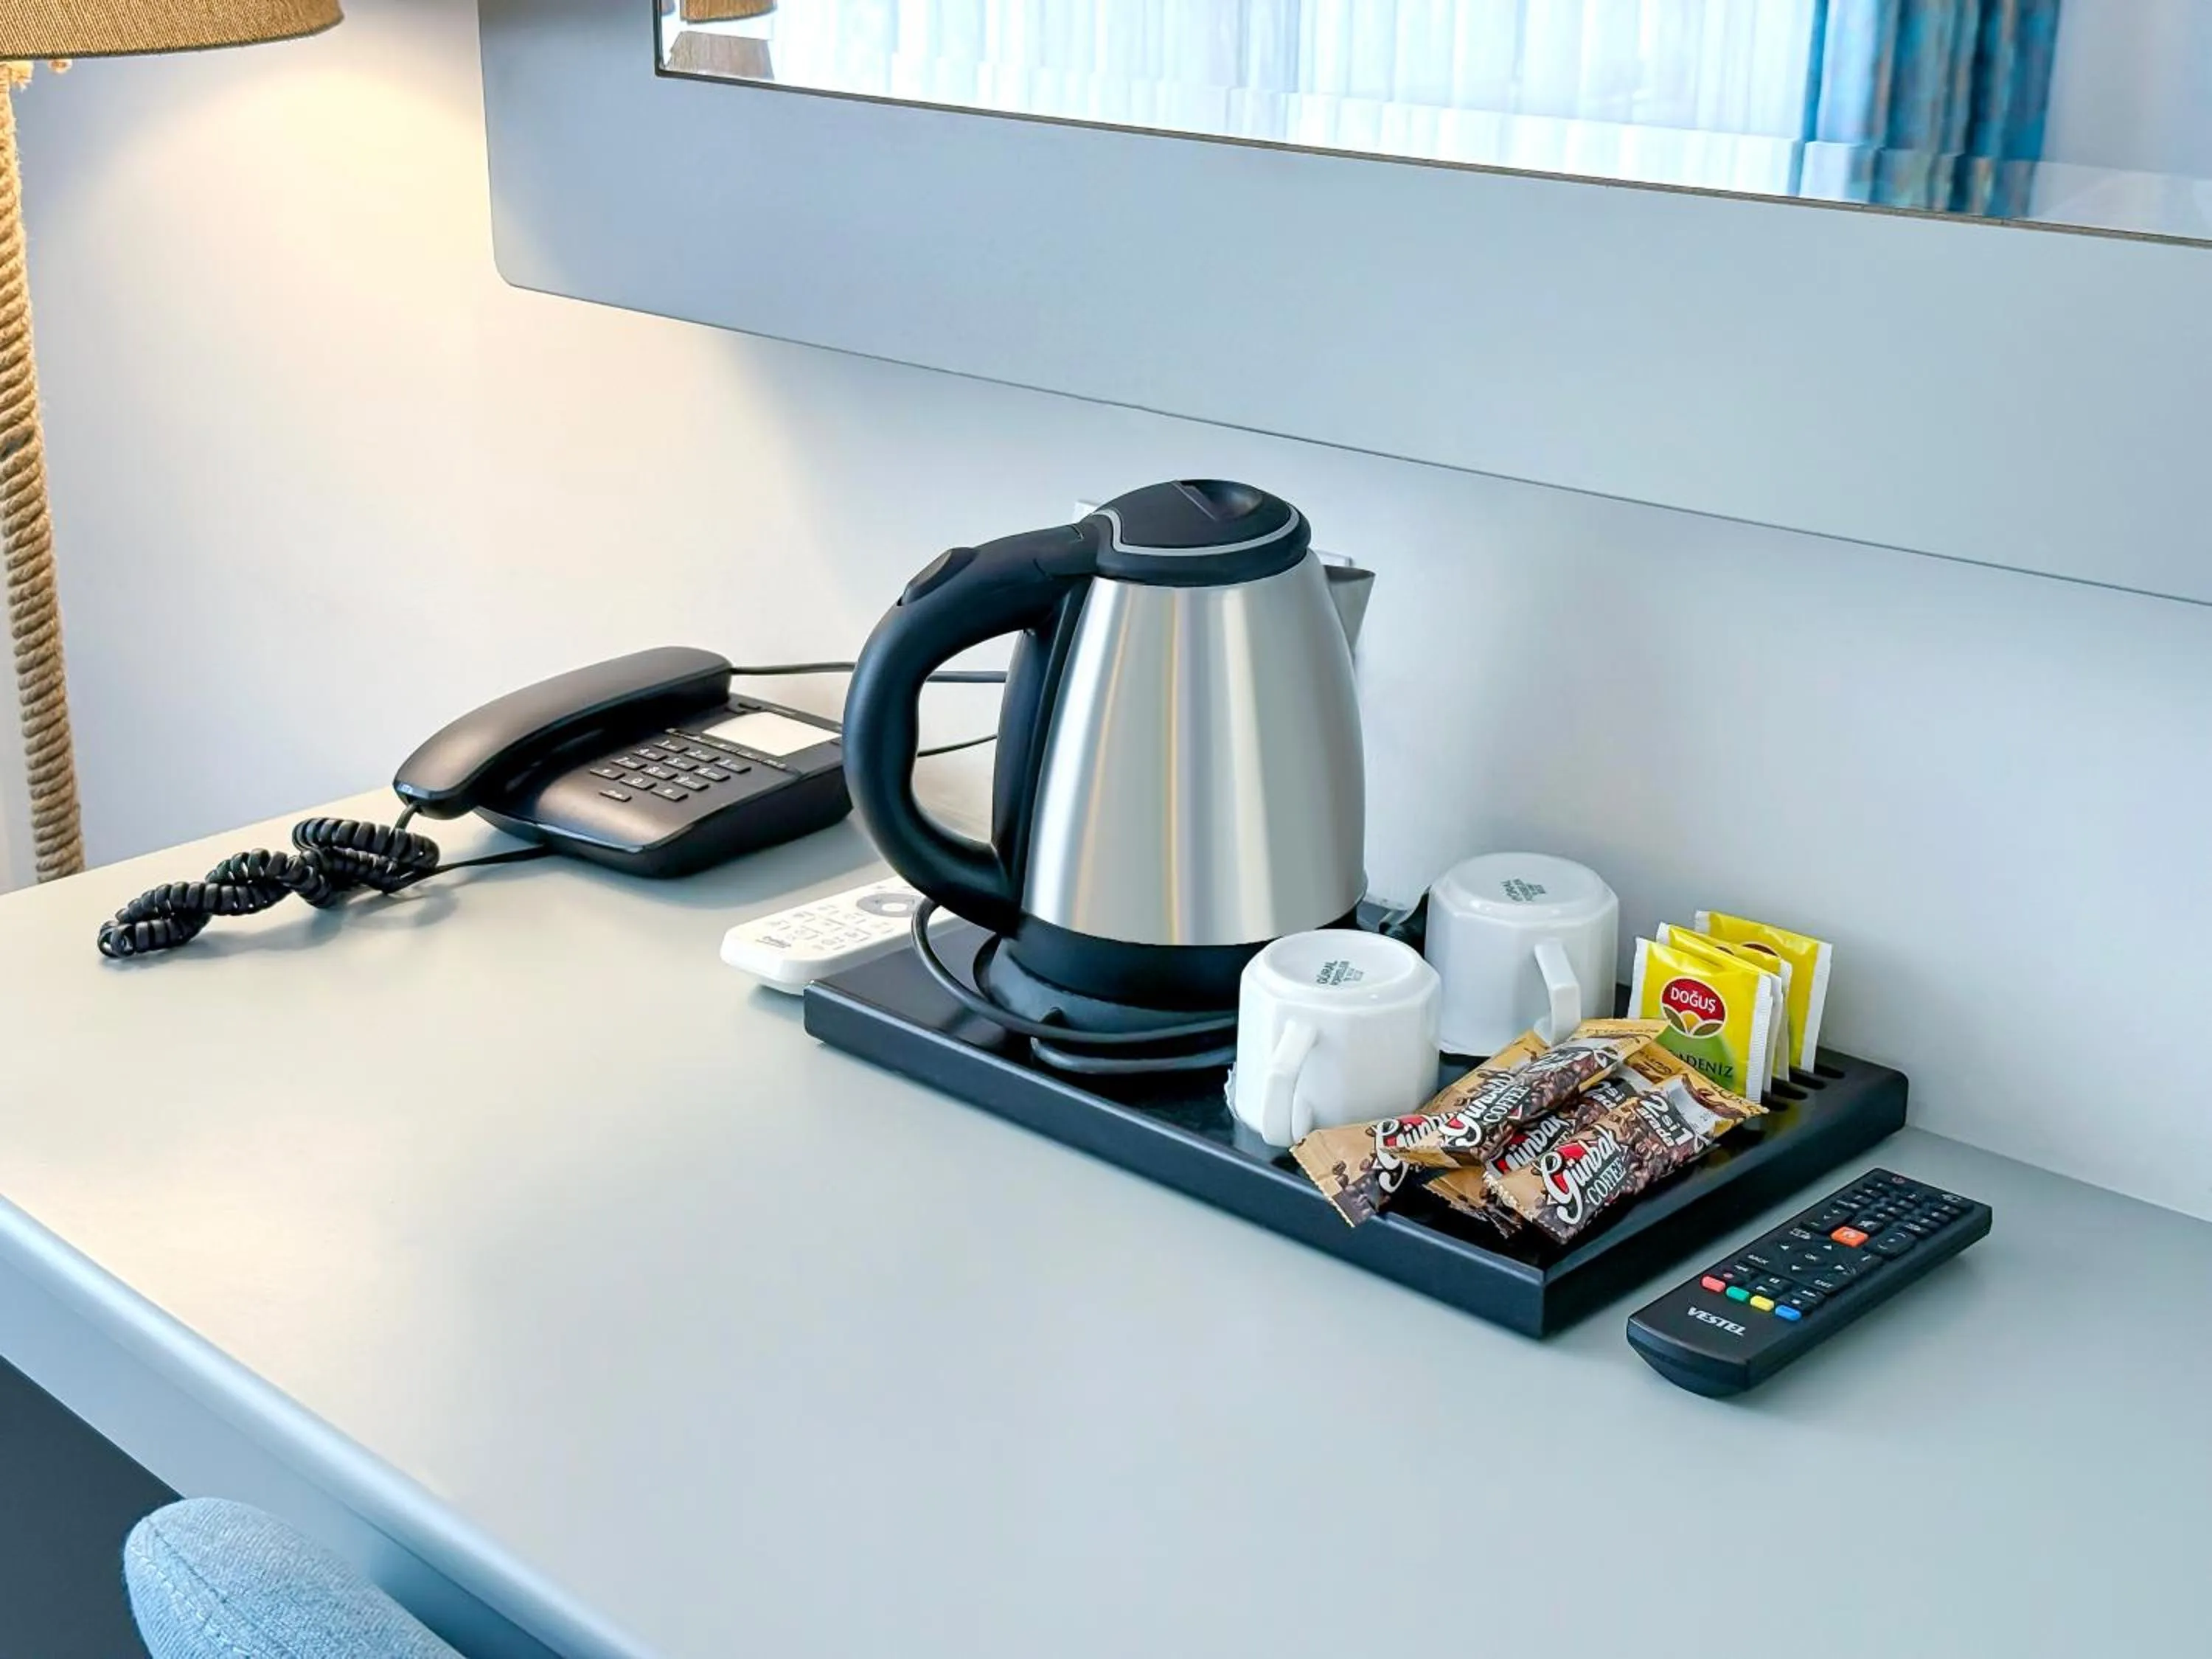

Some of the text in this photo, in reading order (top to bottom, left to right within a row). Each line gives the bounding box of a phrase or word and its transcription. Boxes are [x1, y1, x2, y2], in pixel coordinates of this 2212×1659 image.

[1671, 987, 1717, 1014] DOĞUŞ
[1483, 1085, 1531, 1123] COFFEE
[1636, 1107, 1674, 1147] arada
[1533, 1124, 1621, 1225] Günbak
[1586, 1157, 1627, 1206] COFFEE
[1687, 1306, 1747, 1337] VESTEL
